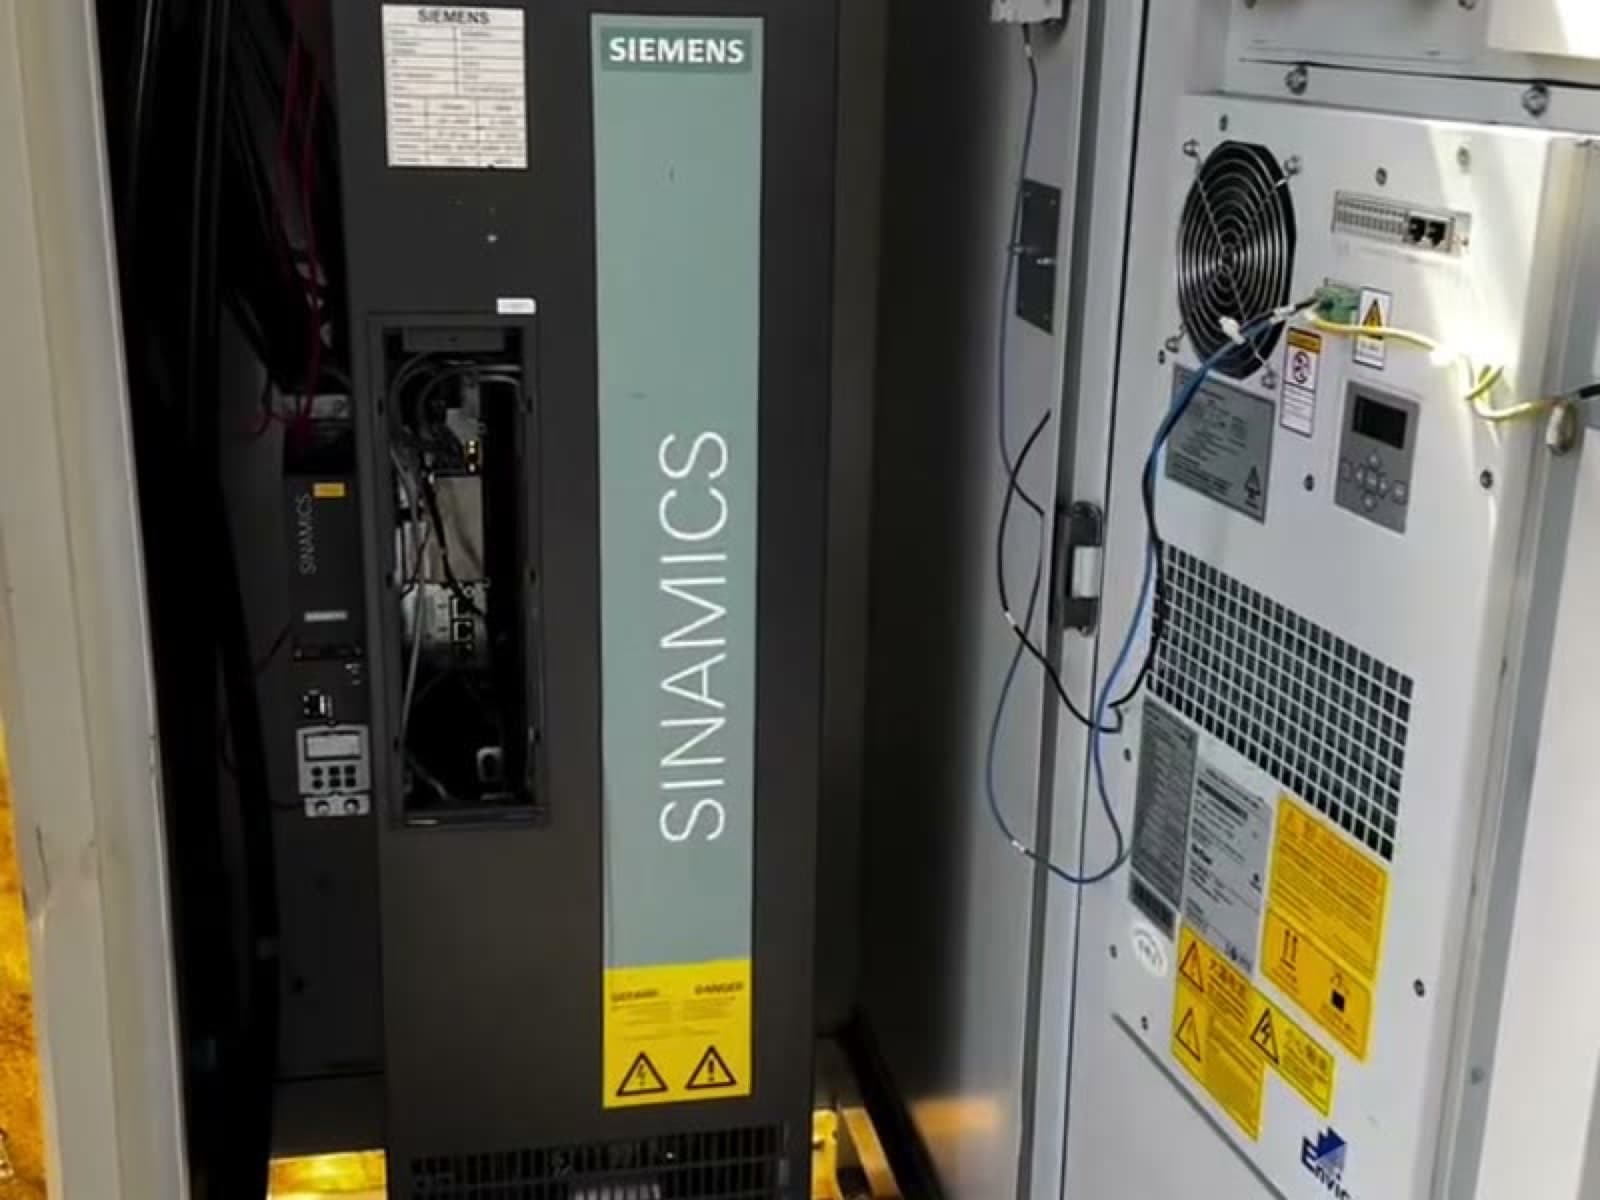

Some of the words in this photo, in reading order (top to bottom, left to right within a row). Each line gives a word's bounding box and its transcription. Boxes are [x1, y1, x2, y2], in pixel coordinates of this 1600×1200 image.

[417, 9, 490, 24] SIEMENS
[609, 36, 745, 64] SIEMENS
[296, 493, 316, 576] SINAMICS
[658, 431, 729, 842] SINAMICS
